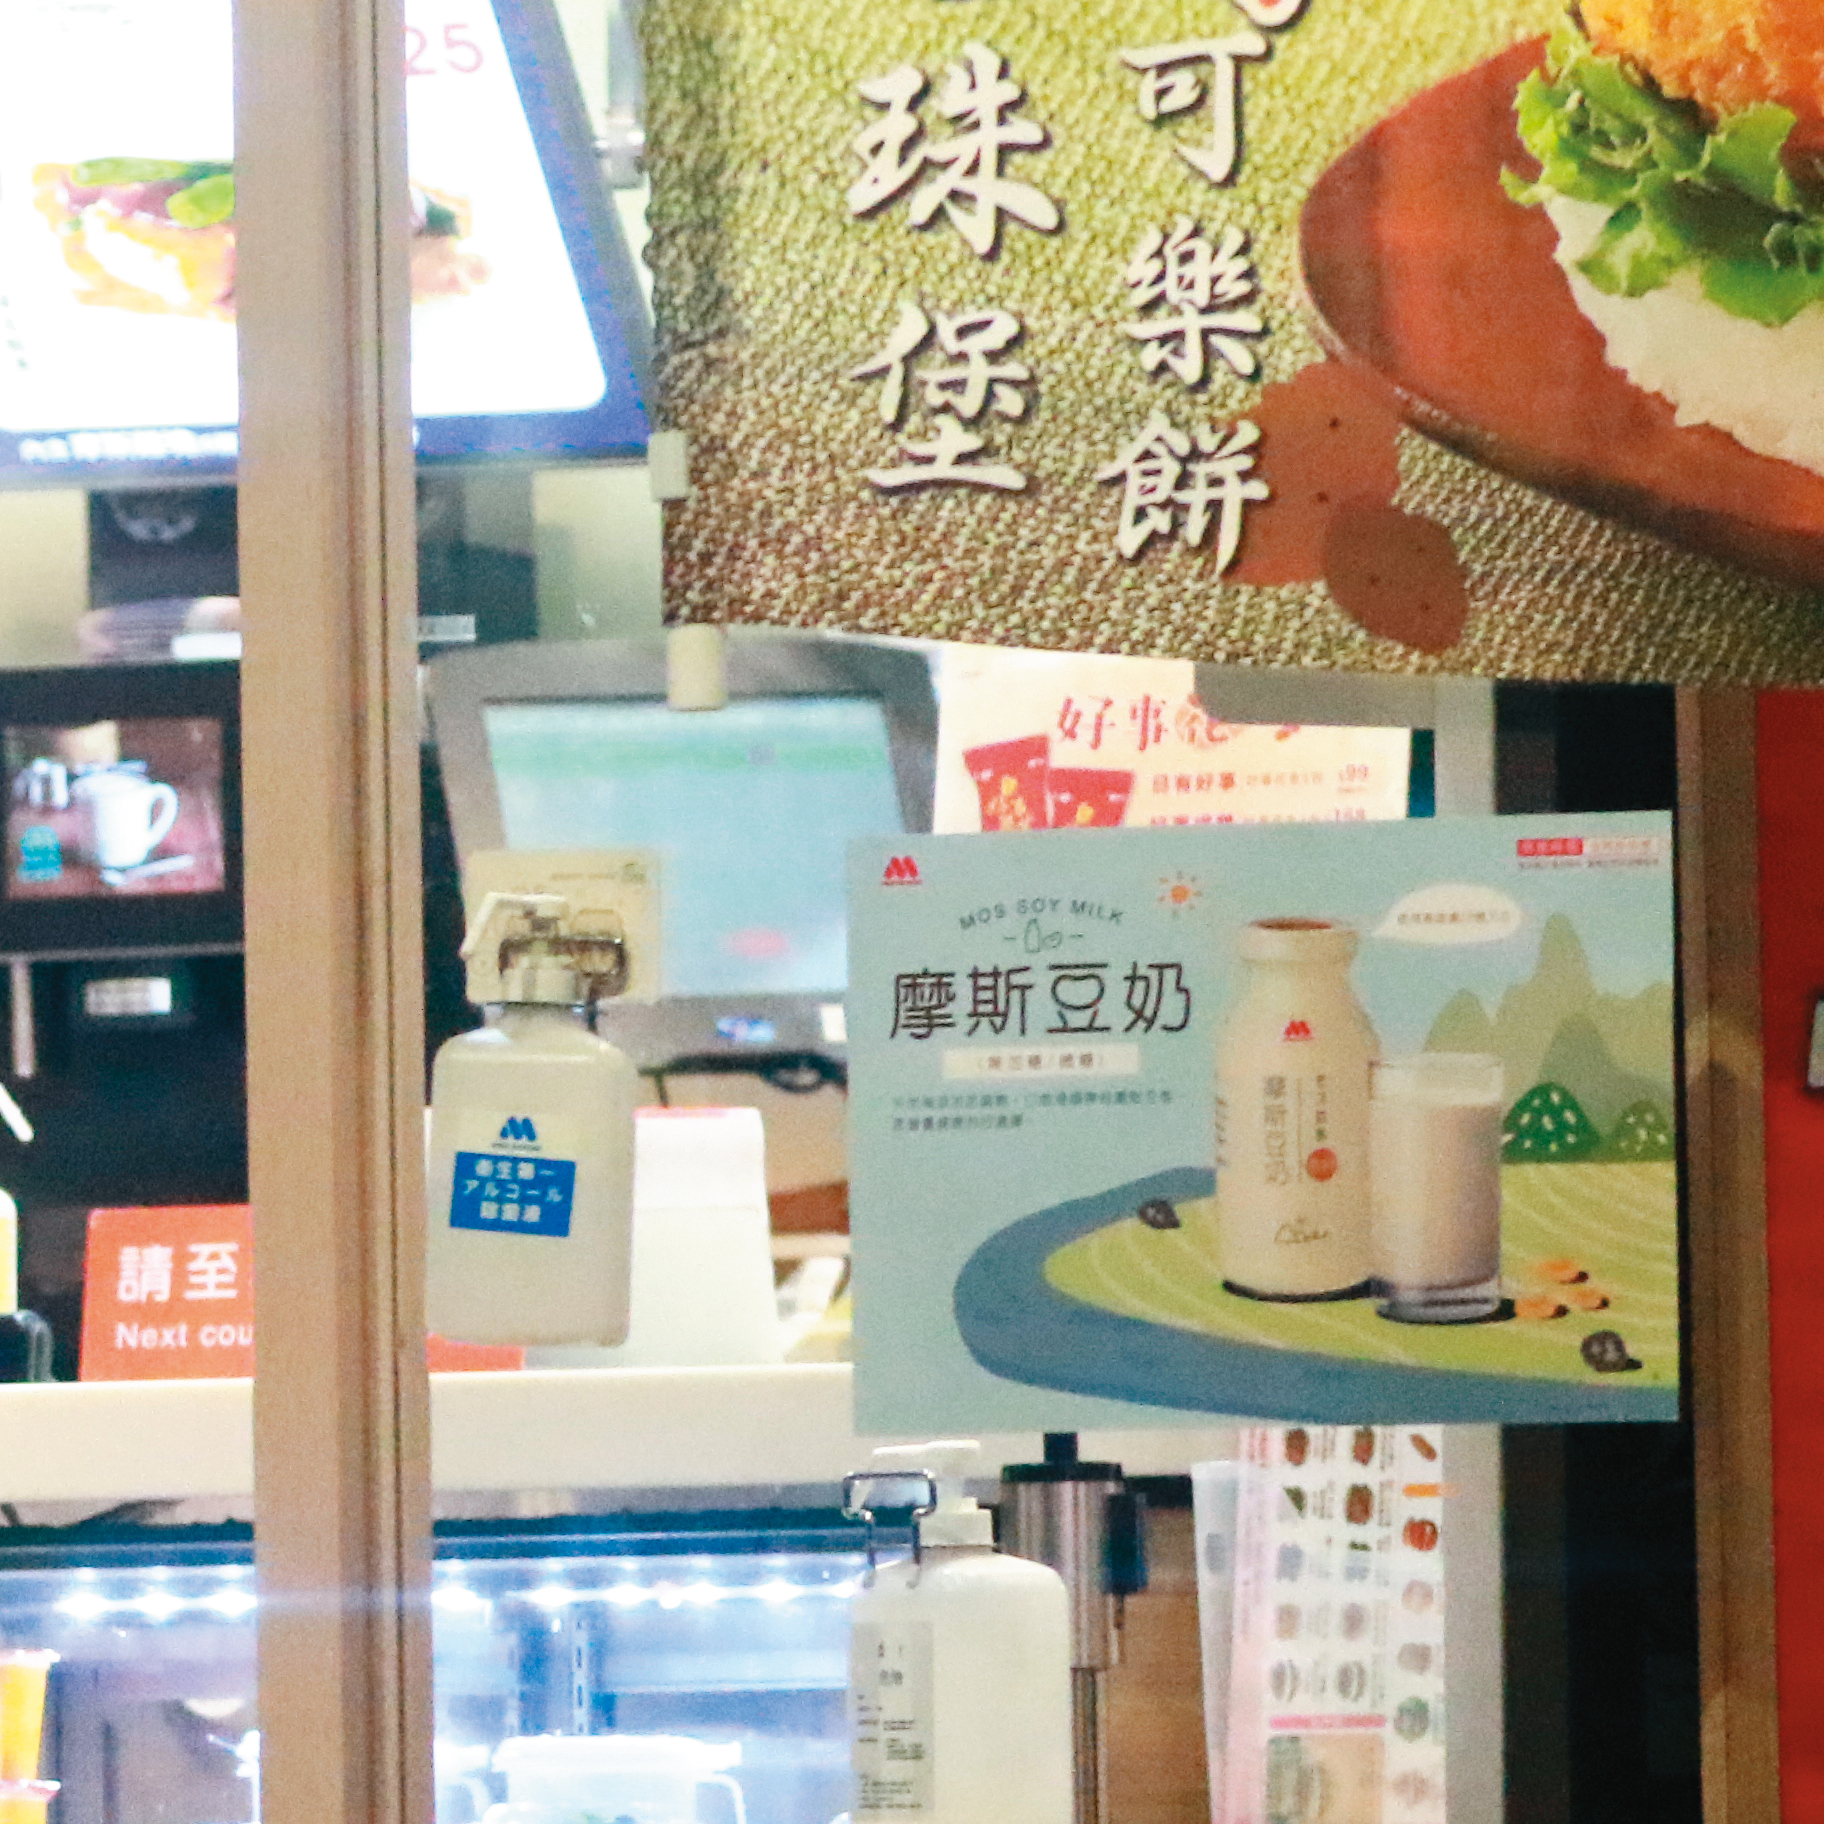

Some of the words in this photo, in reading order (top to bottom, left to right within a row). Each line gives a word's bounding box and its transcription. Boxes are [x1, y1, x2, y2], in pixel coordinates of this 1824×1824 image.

[959, 903, 1007, 930] MOS
[1016, 898, 1059, 915] SOY
[1070, 899, 1125, 926] MILK
[889, 960, 1193, 1040] 摩斯豆奶
[118, 1242, 240, 1304] 請至
[115, 1322, 188, 1351] Next
